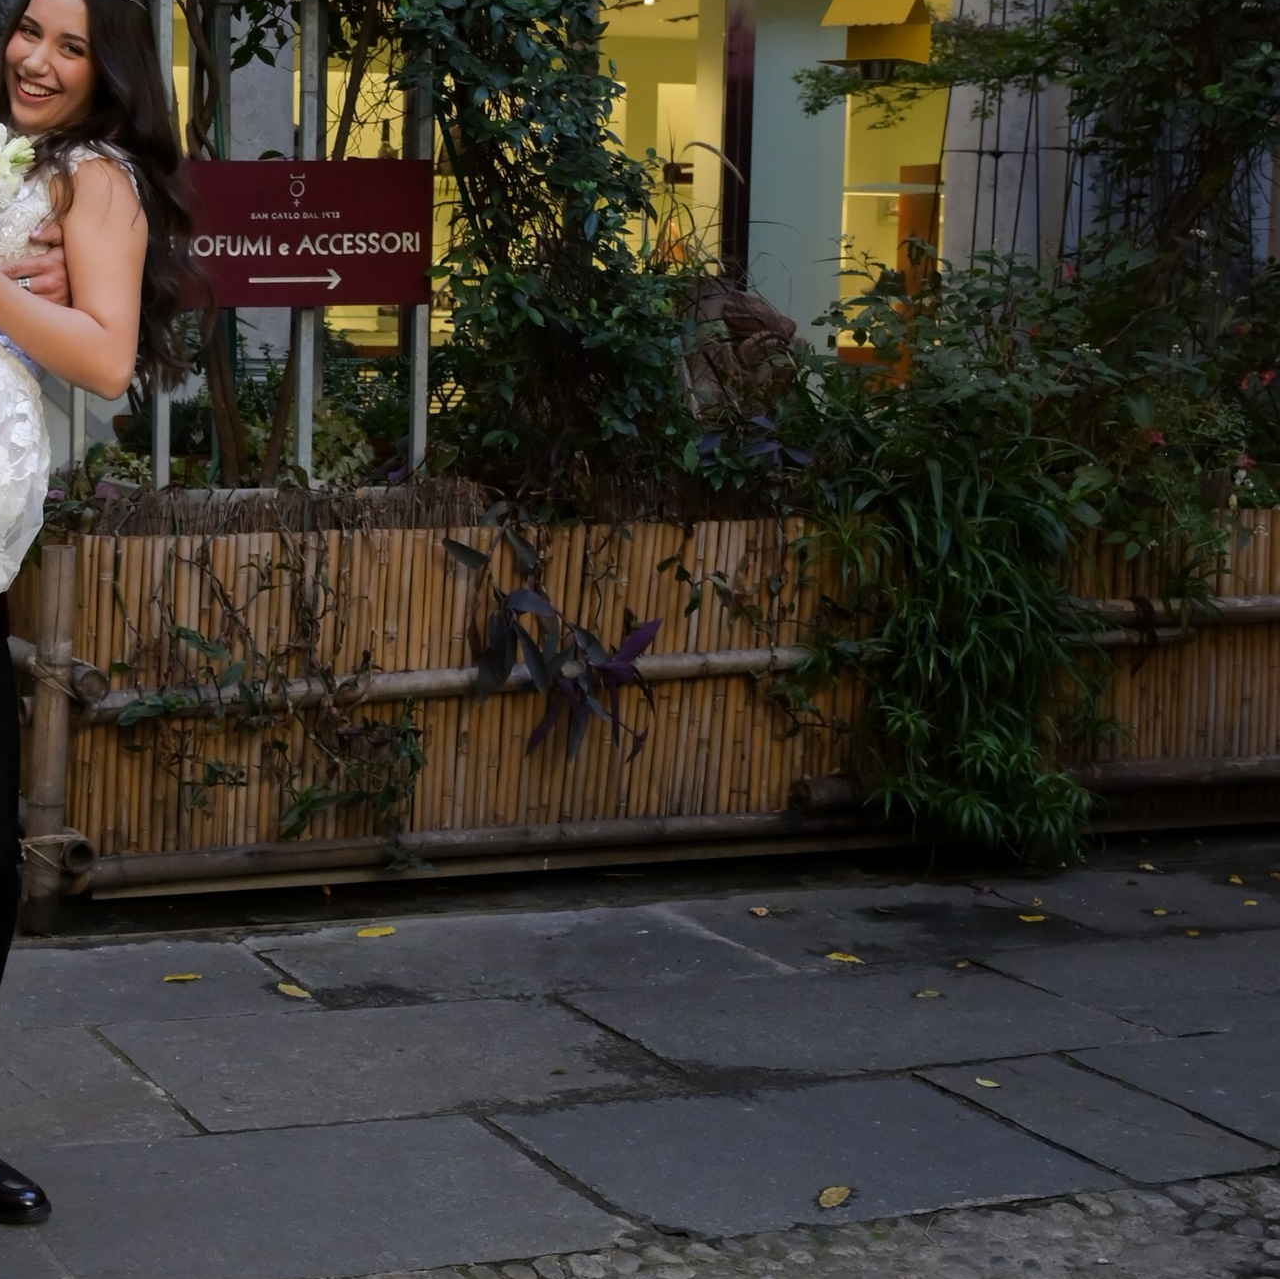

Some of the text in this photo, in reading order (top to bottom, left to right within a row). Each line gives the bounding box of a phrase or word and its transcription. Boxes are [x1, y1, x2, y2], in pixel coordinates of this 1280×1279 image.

[250, 211, 341, 220] SAN CARLO DAL 1973
[169, 232, 420, 257] OFUMI e ACCESSORI
